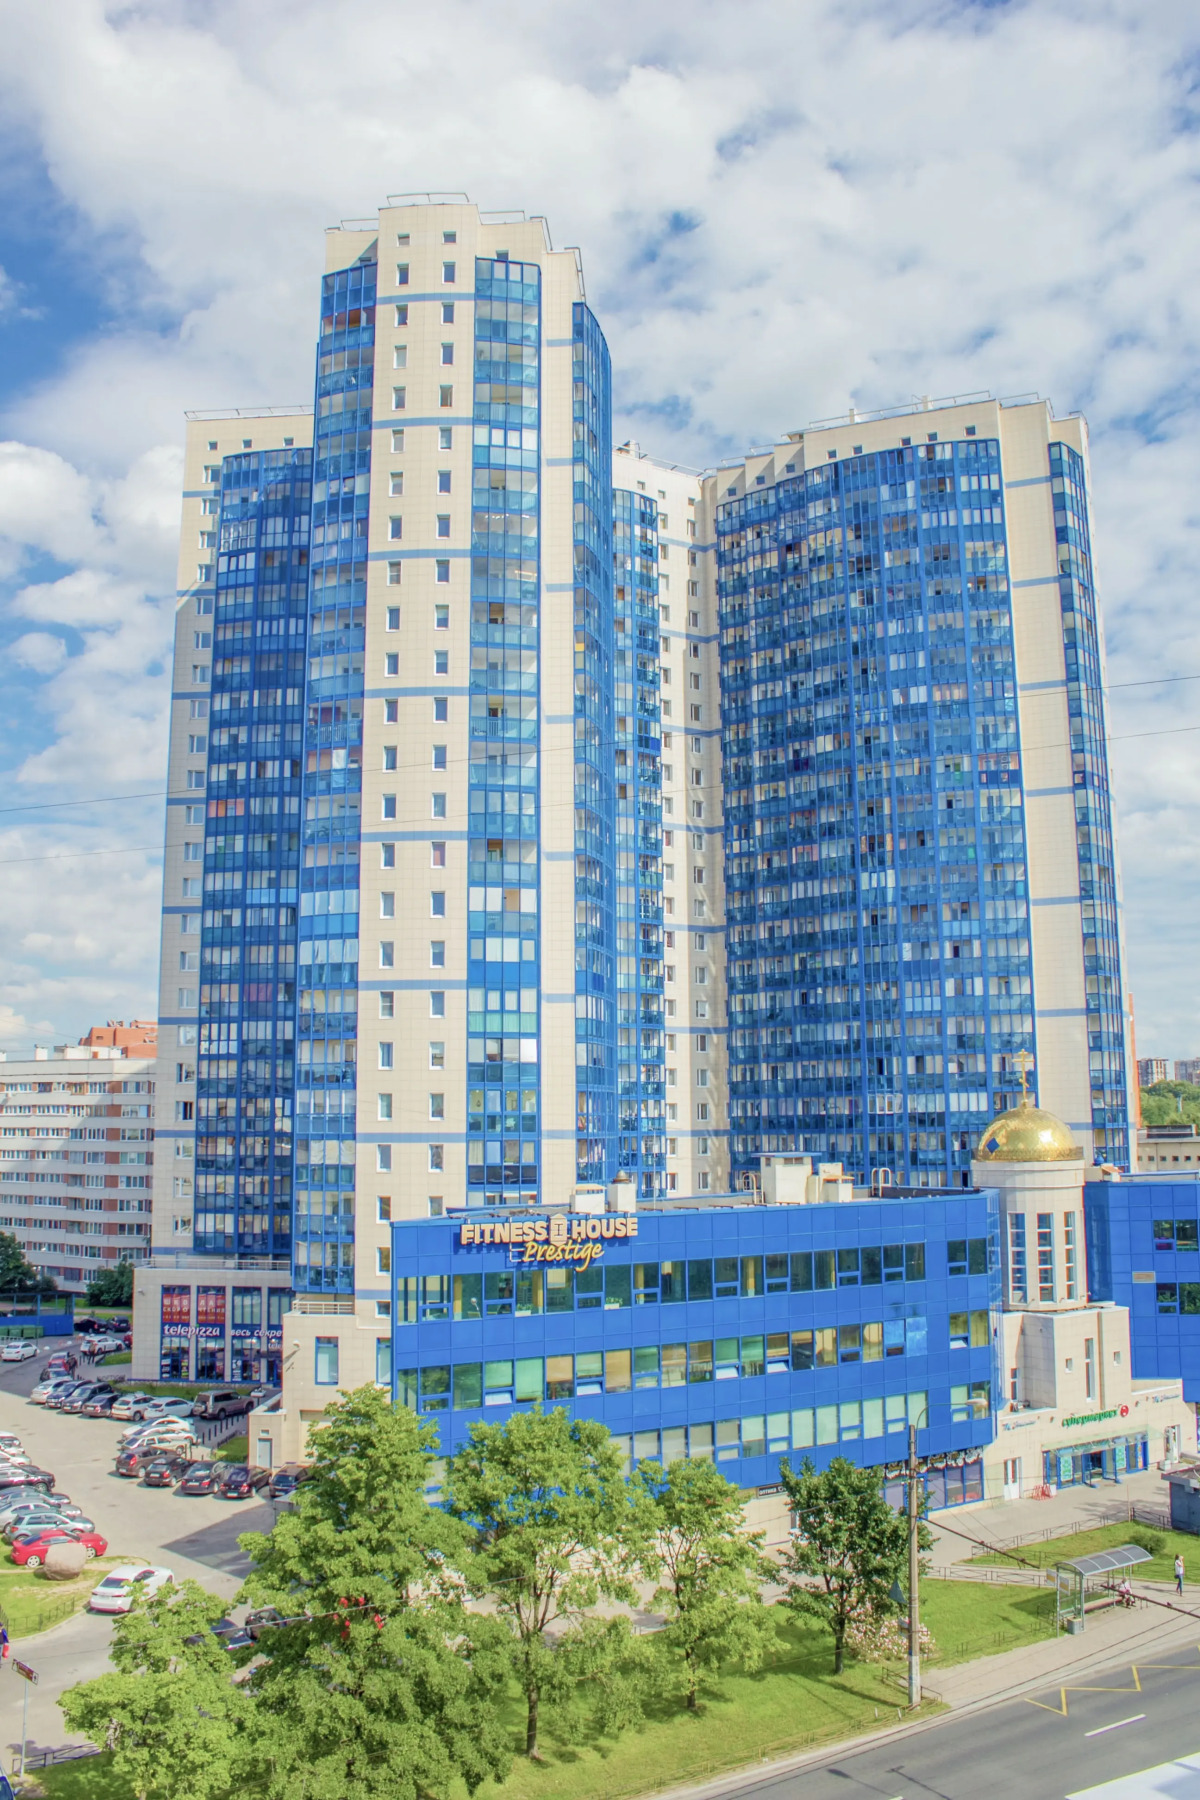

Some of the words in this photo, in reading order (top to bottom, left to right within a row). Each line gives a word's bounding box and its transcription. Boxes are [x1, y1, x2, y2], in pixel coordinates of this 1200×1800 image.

[461, 1221, 548, 1245] FITNESS
[572, 1217, 638, 1239] HOUSE
[523, 1237, 604, 1272] Prestige
[163, 1324, 220, 1338] telepizza
[230, 1329, 251, 1337] весь
[254, 1329, 283, 1338] секре
